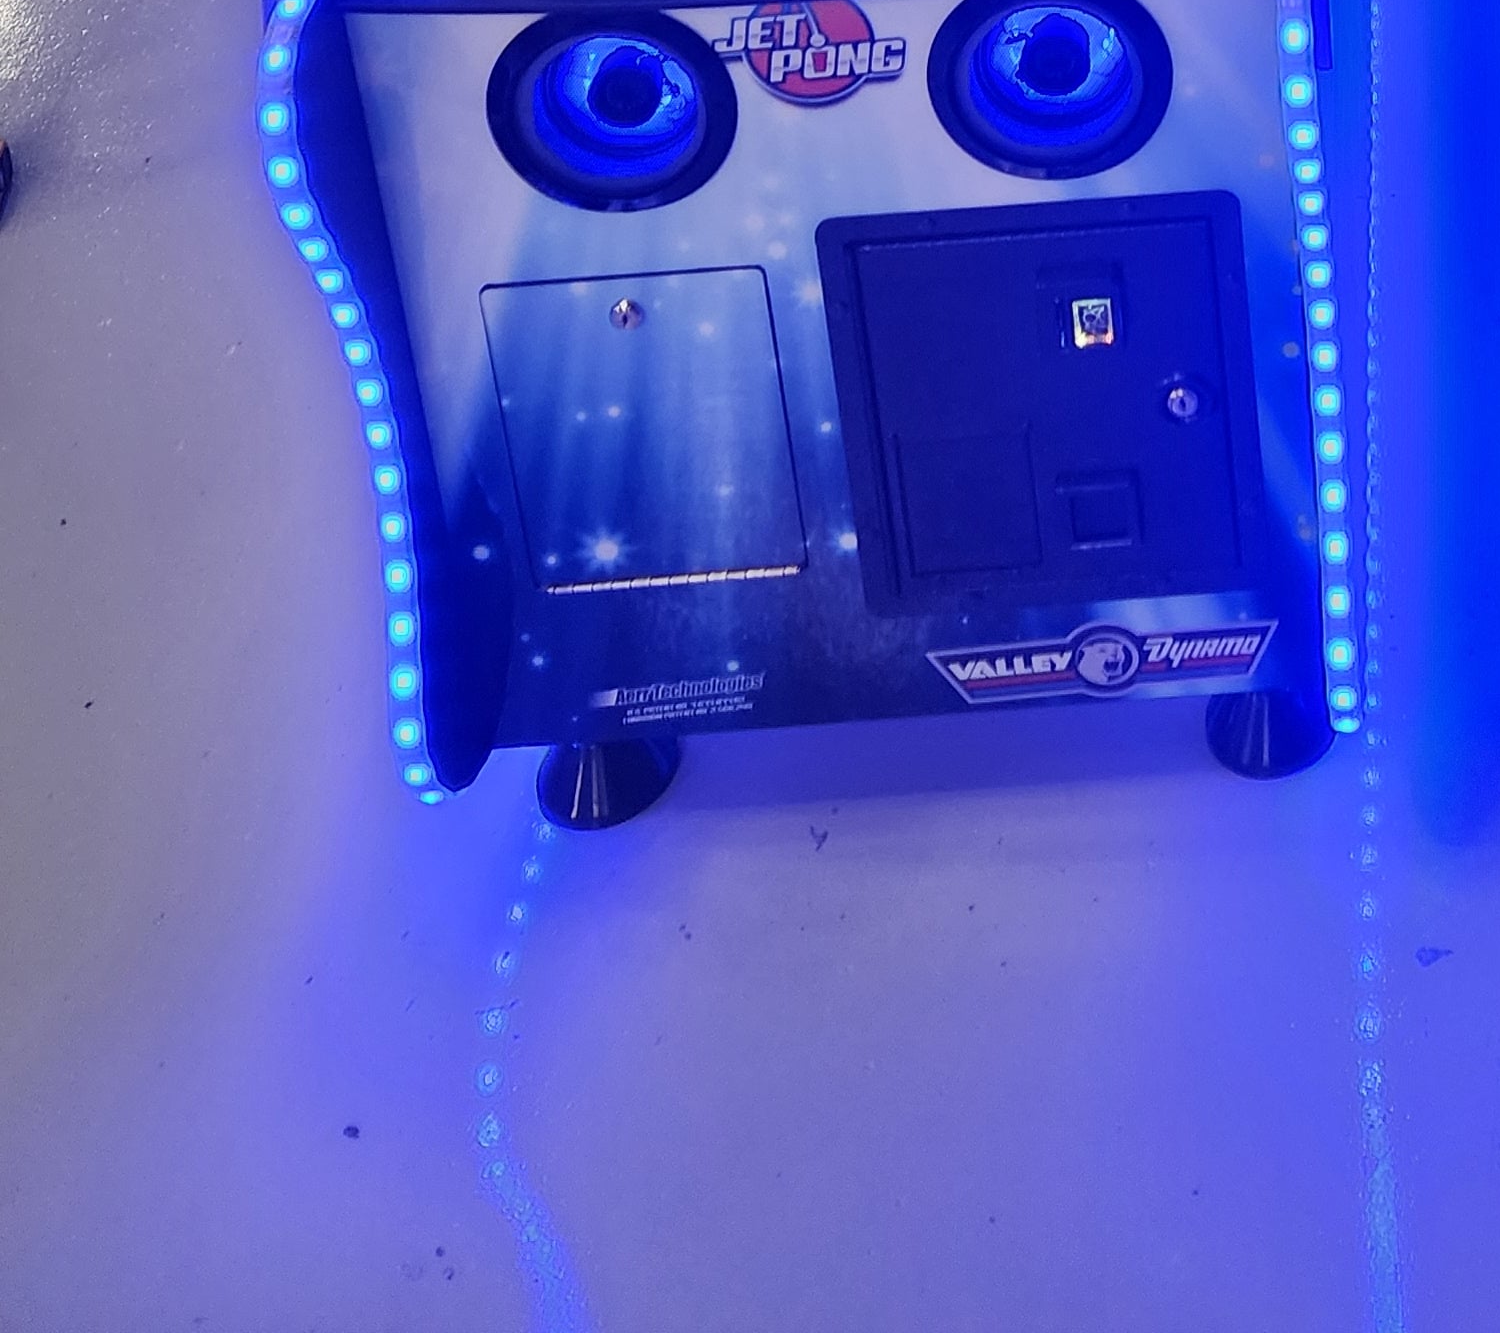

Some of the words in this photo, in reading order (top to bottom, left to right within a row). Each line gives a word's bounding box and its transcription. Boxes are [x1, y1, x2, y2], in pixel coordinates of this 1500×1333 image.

[713, 12, 808, 54] JET
[769, 38, 905, 84] PONG
[948, 649, 1074, 682] VALLEY
